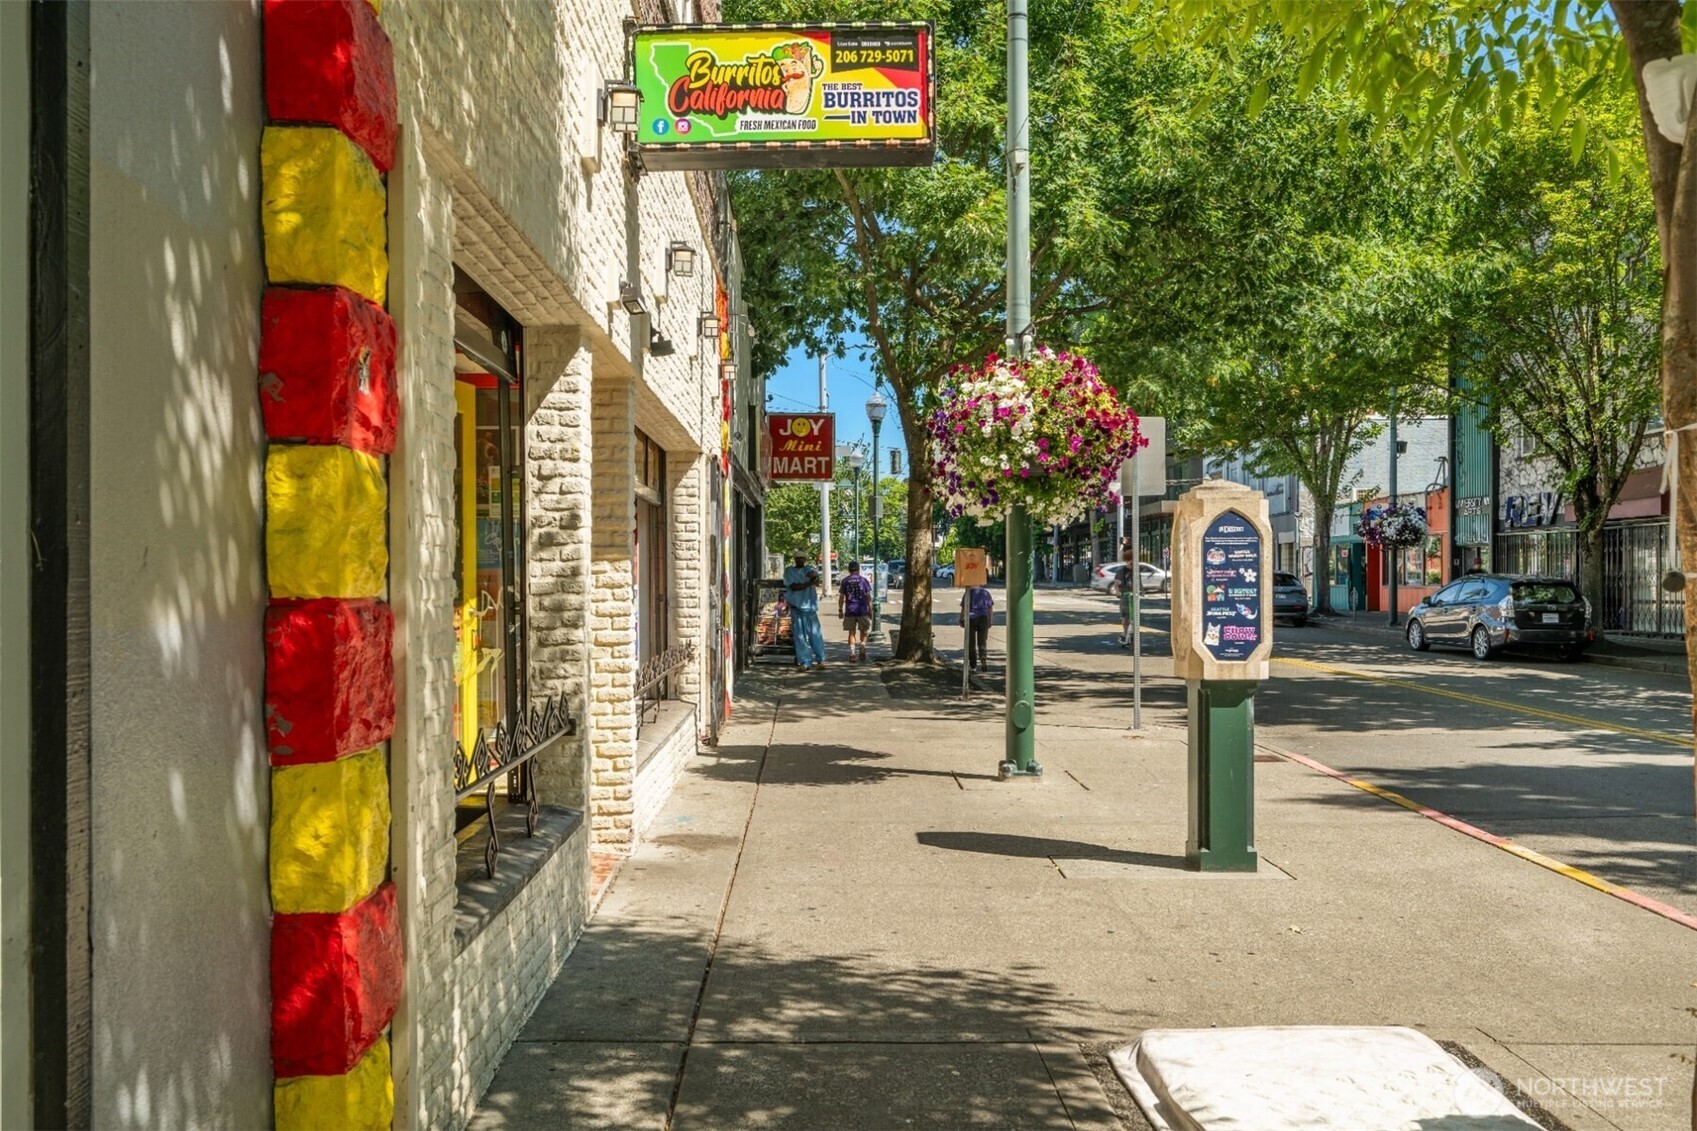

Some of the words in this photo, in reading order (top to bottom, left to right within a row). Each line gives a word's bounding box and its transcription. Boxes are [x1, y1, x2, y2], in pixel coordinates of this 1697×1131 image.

[836, 51, 858, 63] 206
[860, 50, 914, 63] 729-5071
[686, 50, 782, 88] Burritos
[822, 83, 839, 91] THE
[841, 83, 862, 91] BEST
[669, 76, 784, 115] California
[823, 91, 919, 108] BURRITOS
[740, 120, 763, 130] FRESH
[764, 119, 797, 130] MEXICAN
[798, 119, 816, 130] FOOD
[851, 110, 867, 124] IN
[872, 110, 917, 124] TOWN
[779, 417, 825, 437] JOY
[779, 440, 822, 452] Mini
[773, 456, 830, 474] MART
